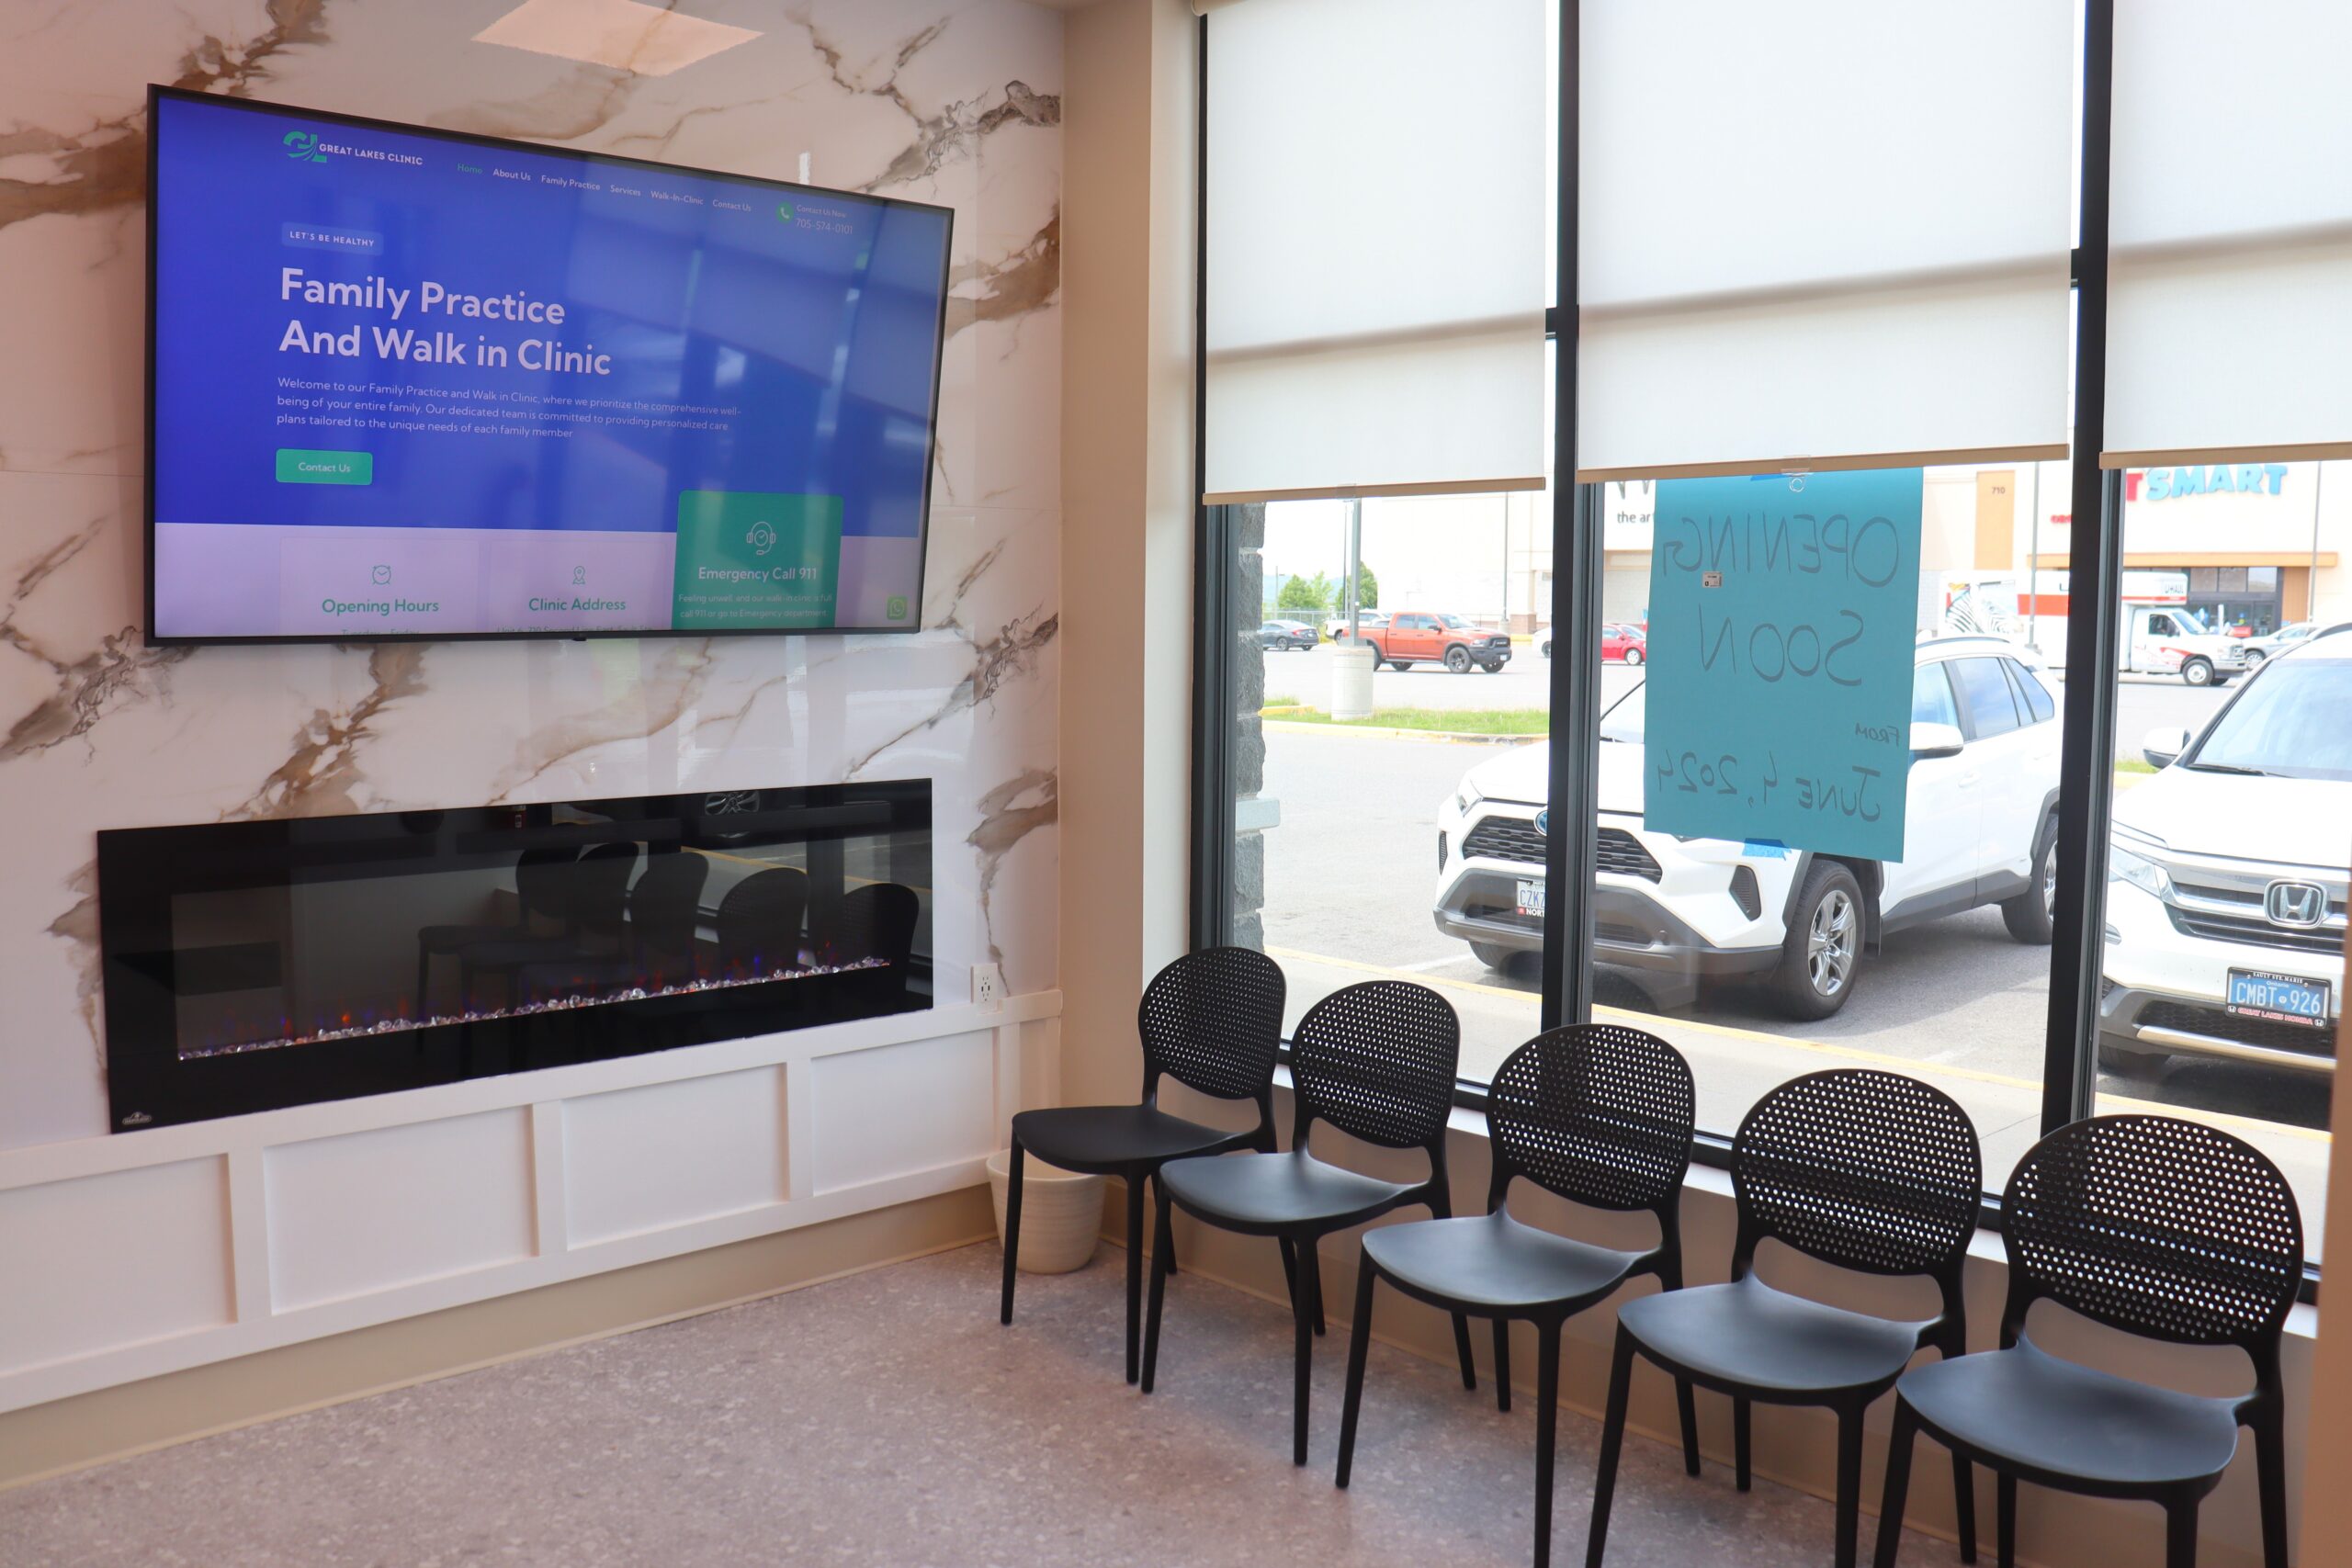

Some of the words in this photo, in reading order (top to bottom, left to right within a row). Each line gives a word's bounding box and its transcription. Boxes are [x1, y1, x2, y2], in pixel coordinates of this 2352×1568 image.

[319, 143, 352, 155] GREAT
[355, 148, 385, 161] LAKES
[388, 152, 424, 165] CLINIC
[457, 163, 483, 175] Home
[492, 168, 519, 180] About
[520, 172, 531, 182] Us
[541, 175, 568, 188] Family
[569, 178, 601, 191] Practice
[610, 184, 641, 197] Services
[712, 199, 741, 211] Contact
[742, 203, 752, 212] Us
[797, 204, 822, 215] Contact
[289, 231, 315, 241] LET'S
[318, 234, 330, 243] BE
[333, 236, 375, 247] HEALTHY
[281, 267, 411, 321] Family
[421, 281, 566, 325] Practice
[278, 320, 361, 357] And
[372, 326, 467, 366] Walk
[477, 335, 507, 367] in
[517, 339, 611, 376] Clinic
[277, 377, 331, 390] Welcome
[334, 382, 345, 391] to
[347, 384, 367, 392] our
[369, 382, 404, 397] Family
[406, 385, 447, 398] Practice
[450, 389, 469, 399] and
[472, 389, 497, 401] Walk
[500, 391, 509, 401] in
[511, 391, 540, 404] Clinic,
[543, 395, 572, 405] where
[574, 398, 588, 406] we
[590, 398, 632, 410] prioritize
[634, 400, 649, 411] the
[650, 402, 718, 415] comprehensive
[720, 406, 741, 416] well-
[277, 395, 310, 410] being
[311, 397, 323, 408] of
[326, 401, 352, 411] your
[354, 401, 387, 412] entire
[389, 401, 423, 415] family.
[425, 403, 446, 414] Our
[447, 405, 499, 418] dedicated
[502, 410, 527, 419] team
[529, 410, 537, 420] is
[537, 411, 592, 423] committed
[594, 413, 604, 423] to
[605, 415, 650, 428] providing
[651, 419, 707, 430] personalized
[709, 423, 729, 431] care
[277, 413, 306, 426] plans
[310, 415, 351, 426] tailored
[355, 418, 366, 427] to
[368, 418, 387, 428] the
[389, 421, 425, 433] unique
[427, 422, 458, 433] needs
[460, 423, 472, 433] of
[474, 424, 498, 434] each
[500, 425, 530, 438] family
[532, 427, 574, 438] member
[298, 461, 336, 472] Contact
[338, 463, 351, 473] Us
[1992, 486, 2006, 495] 710
[1617, 511, 1636, 524] the
[1639, 513, 1654, 524] ar
[698, 567, 769, 583] Emergency
[773, 567, 796, 580] Call
[798, 567, 817, 580] 911
[322, 598, 390, 617] Opening
[394, 598, 439, 612] Hours
[528, 597, 567, 611] Clinic
[571, 598, 627, 611] Address
[678, 594, 707, 605] Feeling
[680, 609, 694, 618] call
[695, 609, 707, 618] 911
[718, 611, 729, 620] go
[730, 609, 738, 618] to
[2253, 971, 2270, 980] SAULT
[2285, 976, 2303, 985] MARIE
[2236, 982, 2278, 1009] CMBT
[2290, 989, 2321, 1015] 926
